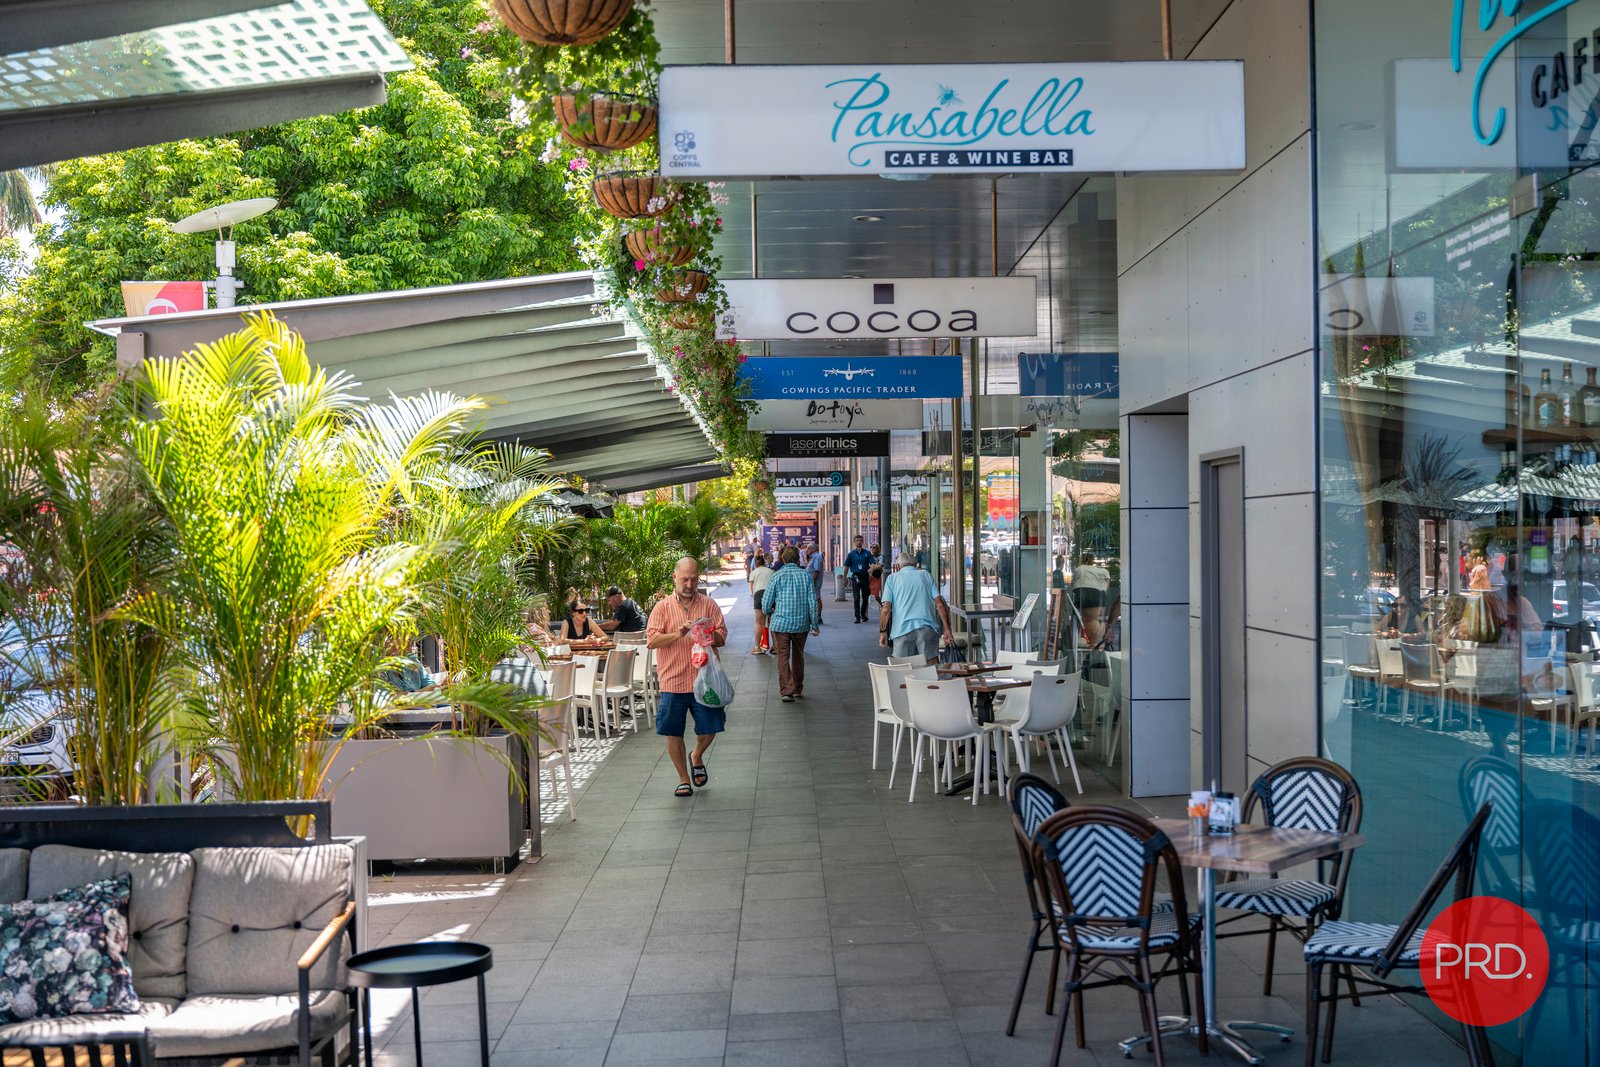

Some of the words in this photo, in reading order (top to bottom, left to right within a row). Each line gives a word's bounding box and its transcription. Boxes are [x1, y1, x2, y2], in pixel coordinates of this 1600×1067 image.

[825, 72, 1096, 166] Pansabella
[890, 153, 939, 165] CAFE
[947, 153, 959, 165] &
[967, 152, 1021, 164] WINE
[1030, 151, 1069, 164] BAR
[786, 309, 978, 334] cocoa
[834, 386, 872, 394] PACIFIC
[789, 437, 858, 449] laserclinics
[776, 477, 832, 487] PLATYPUS
